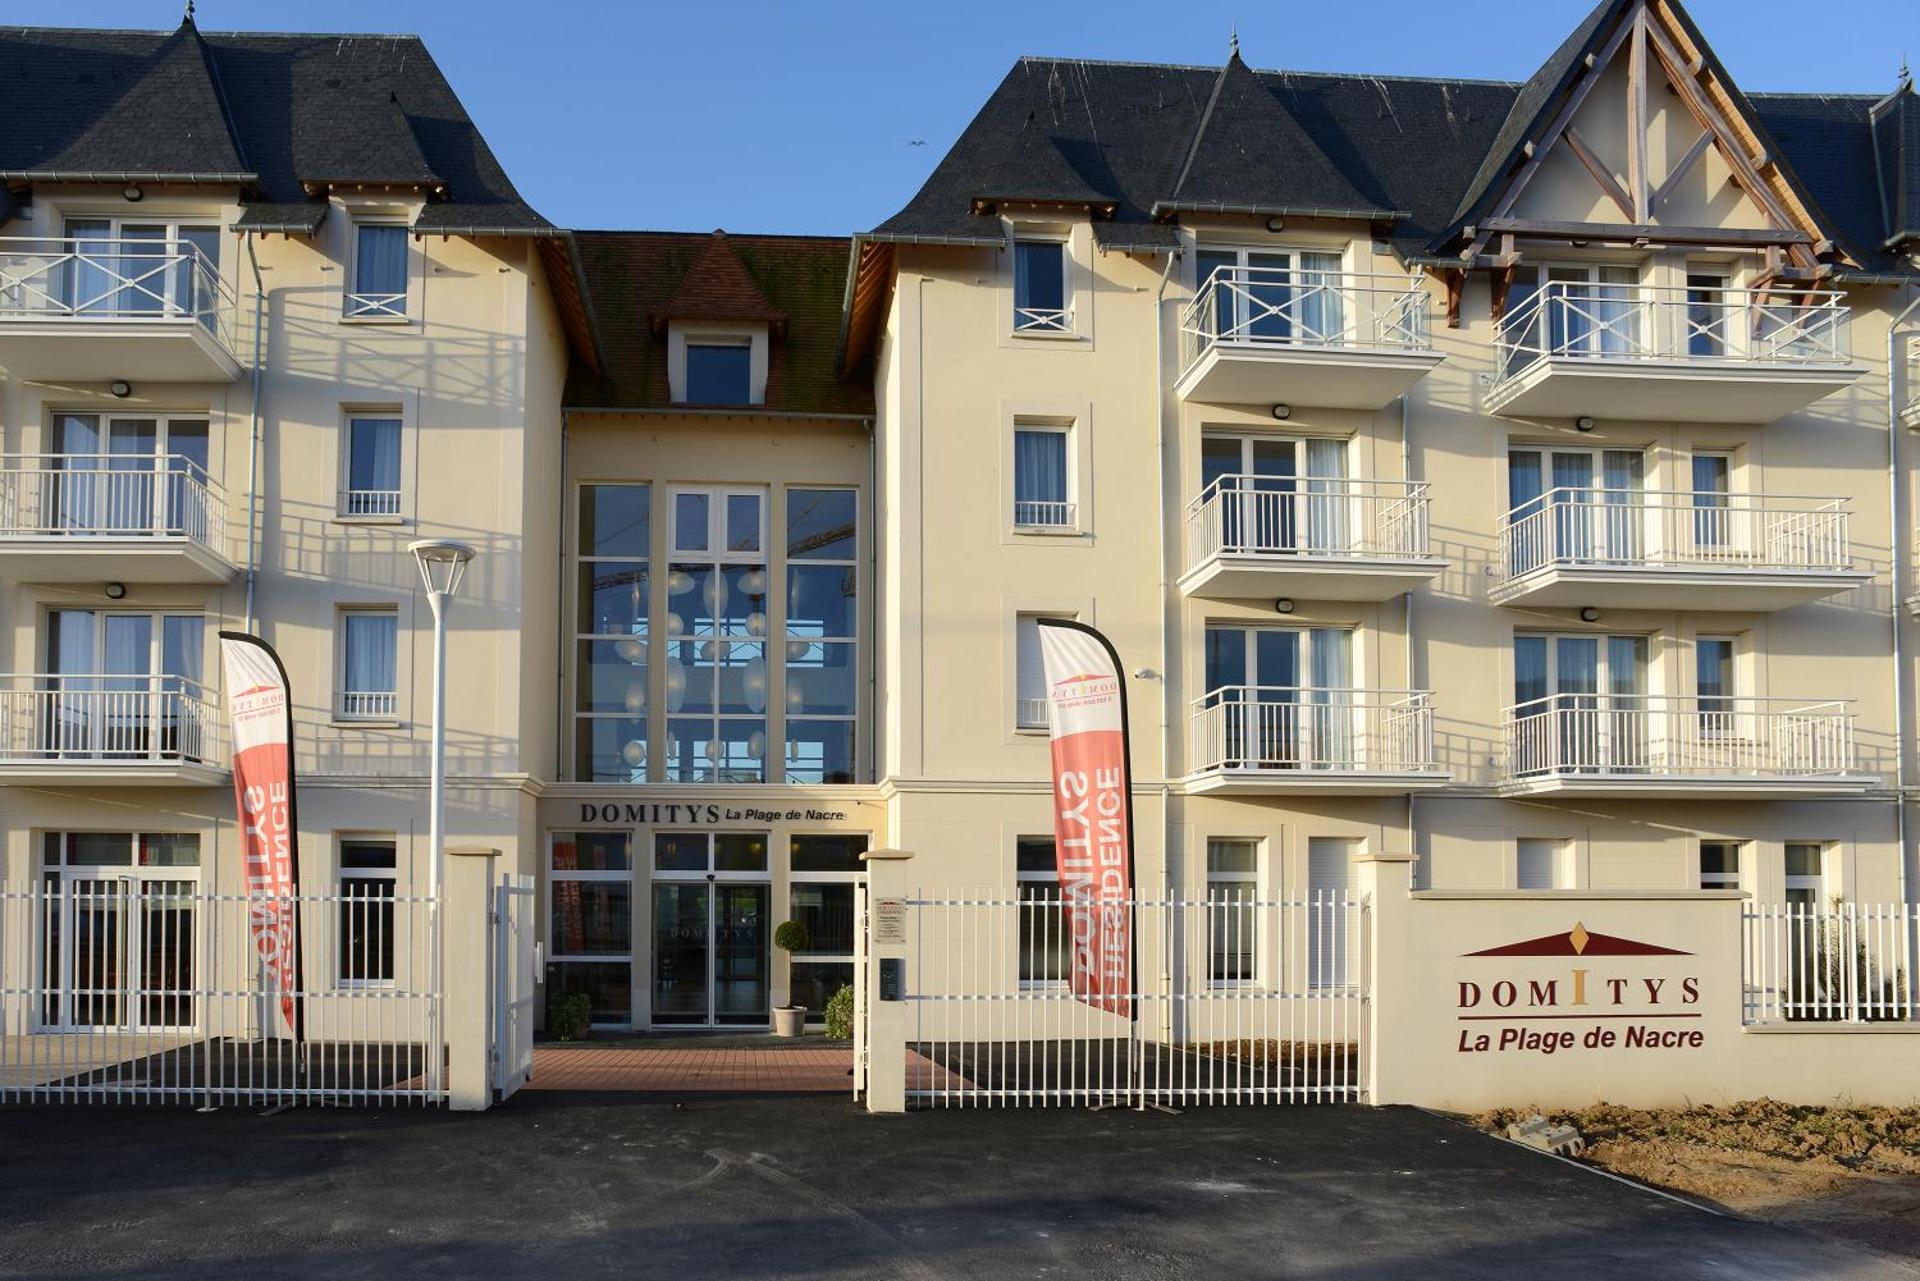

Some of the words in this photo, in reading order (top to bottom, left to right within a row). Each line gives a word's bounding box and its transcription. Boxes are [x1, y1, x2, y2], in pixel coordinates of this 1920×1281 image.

[580, 803, 720, 823] DOMITYS
[725, 808, 741, 820] La
[745, 808, 782, 822] Plage
[785, 808, 802, 820] de
[805, 809, 845, 820] Nacre
[671, 927, 753, 938] DOMTYS
[1457, 968, 1699, 1008] DOMITYS
[1458, 1029, 1490, 1052] La
[1499, 1027, 1575, 1055] Plage
[1583, 1026, 1616, 1048] de
[1625, 1025, 1704, 1049] Nacre
